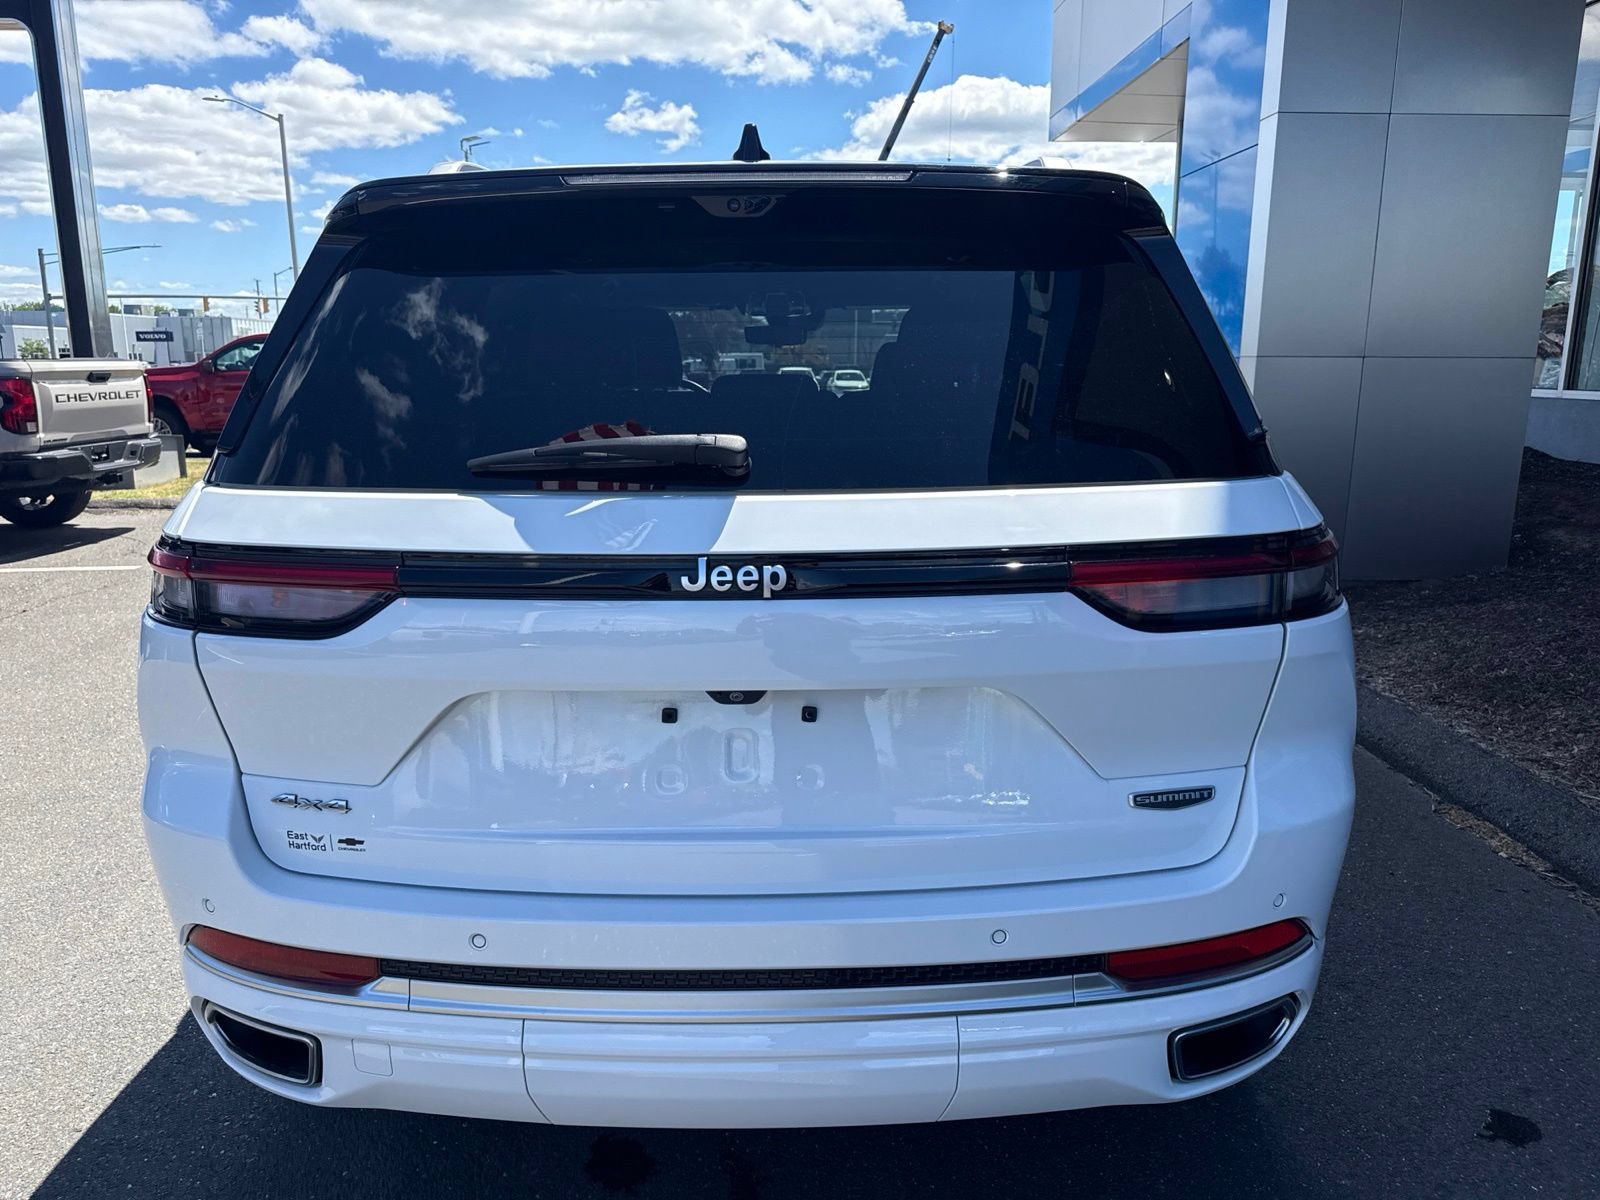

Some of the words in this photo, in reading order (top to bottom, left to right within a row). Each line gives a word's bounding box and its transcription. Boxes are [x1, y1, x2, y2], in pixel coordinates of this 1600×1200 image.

[55, 389, 142, 404] CHEVROLET
[680, 556, 787, 599] Jeep
[1135, 789, 1212, 805] SUMMIT
[286, 830, 309, 841] East
[287, 840, 327, 852] Hartford
